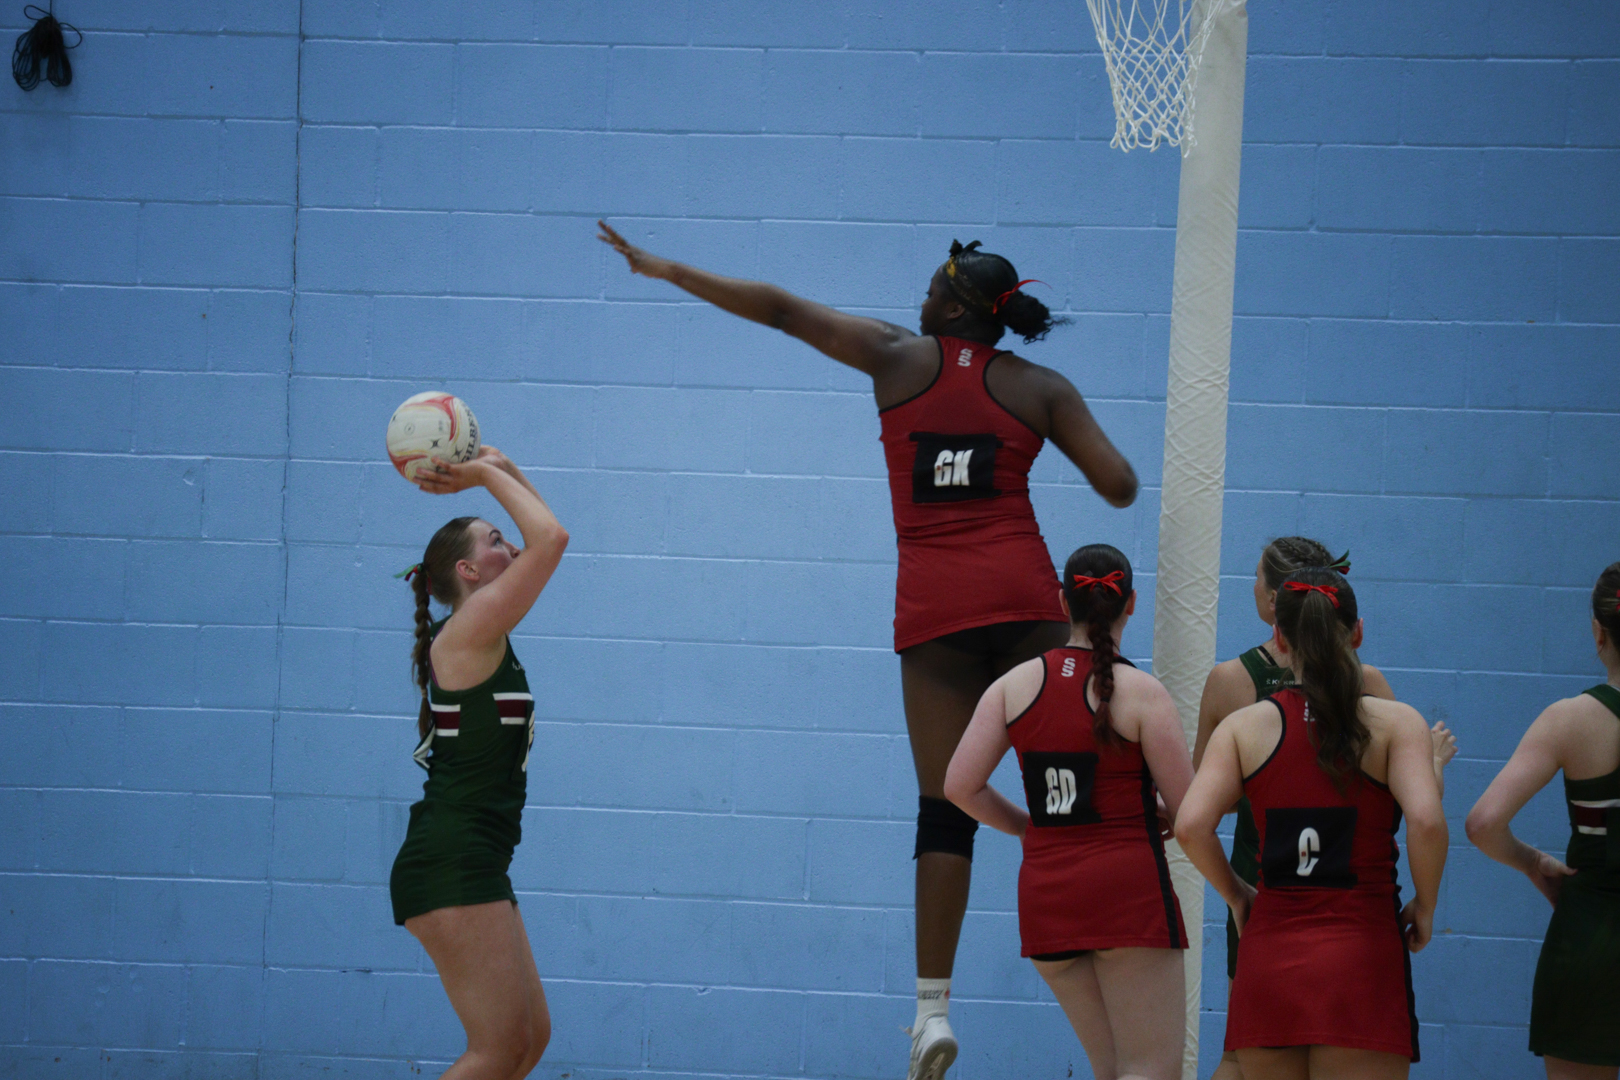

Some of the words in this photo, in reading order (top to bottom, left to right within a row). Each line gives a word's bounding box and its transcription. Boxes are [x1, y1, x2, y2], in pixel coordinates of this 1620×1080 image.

[934, 449, 974, 487] GK
[1045, 766, 1077, 815] GD
[1296, 827, 1321, 876] C
